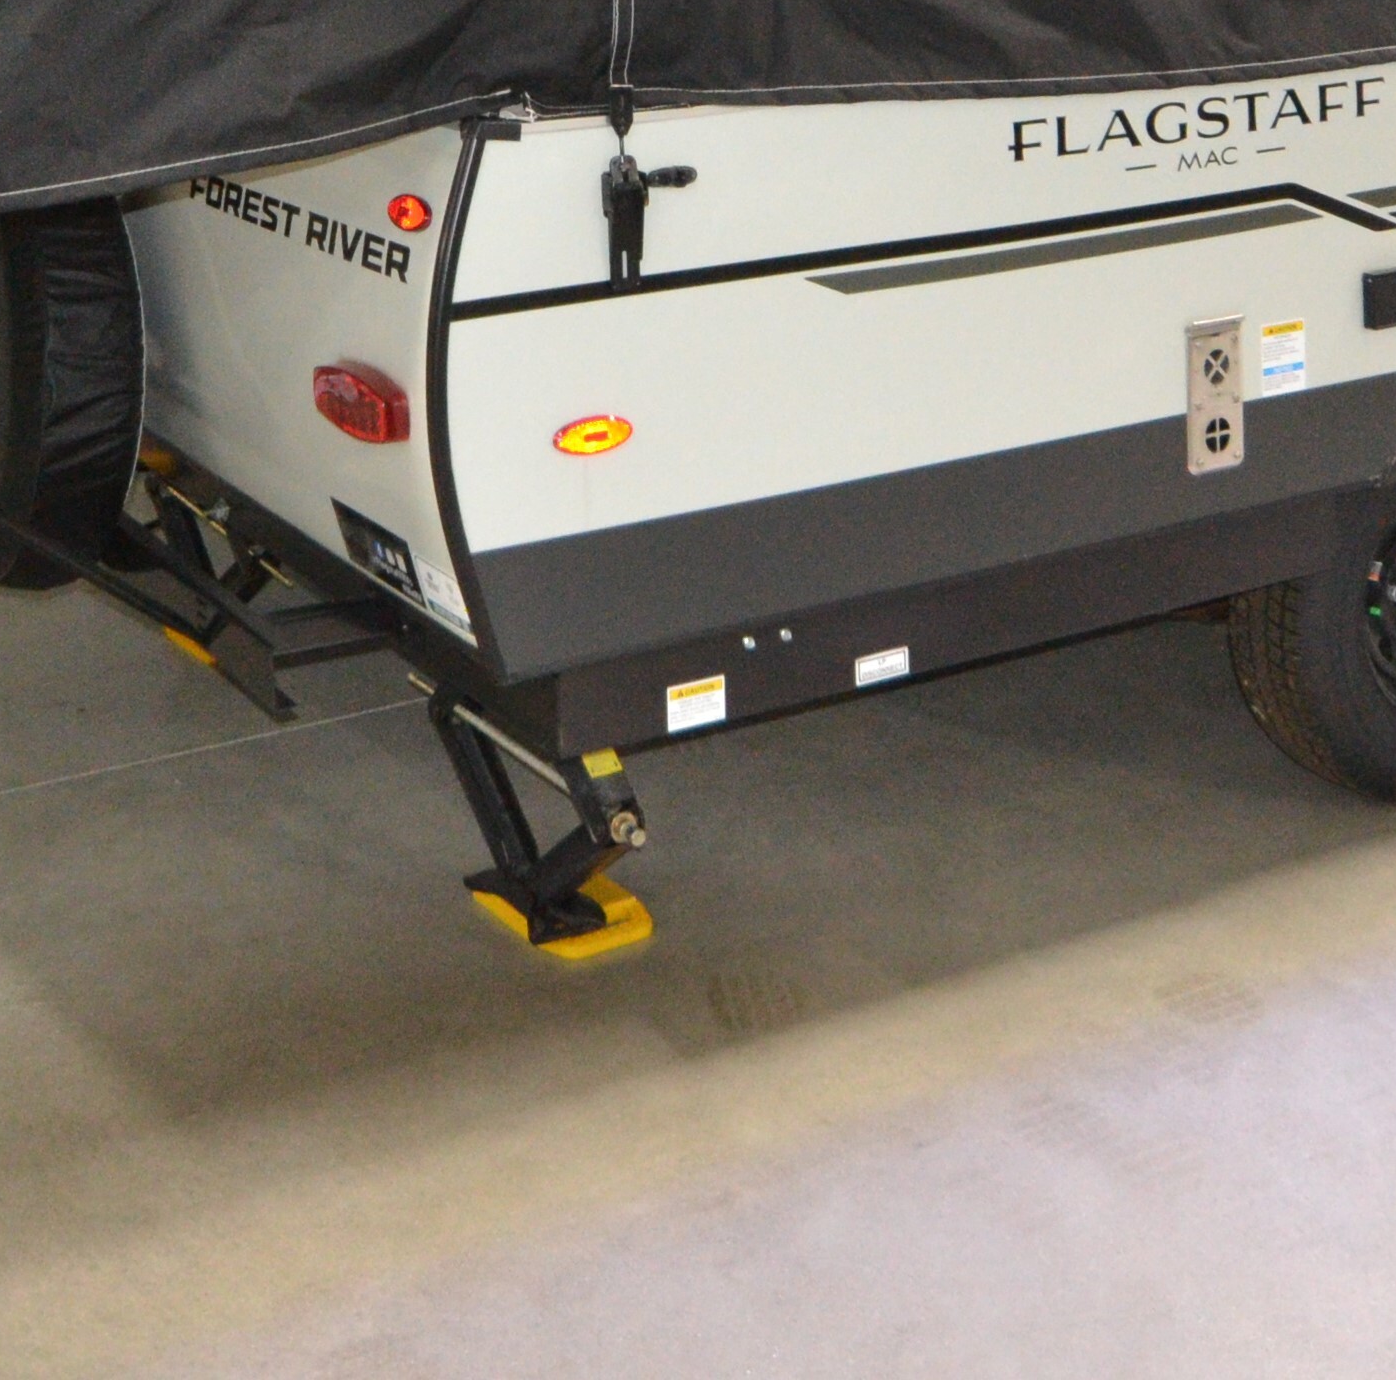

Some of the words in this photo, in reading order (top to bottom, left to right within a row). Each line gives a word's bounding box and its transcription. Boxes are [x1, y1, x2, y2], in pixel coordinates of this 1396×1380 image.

[1008, 76, 1385, 162] FLAGSTAFF
[1177, 146, 1239, 172] MAC
[190, 176, 301, 238] FOREST
[305, 210, 411, 284] RIVER
